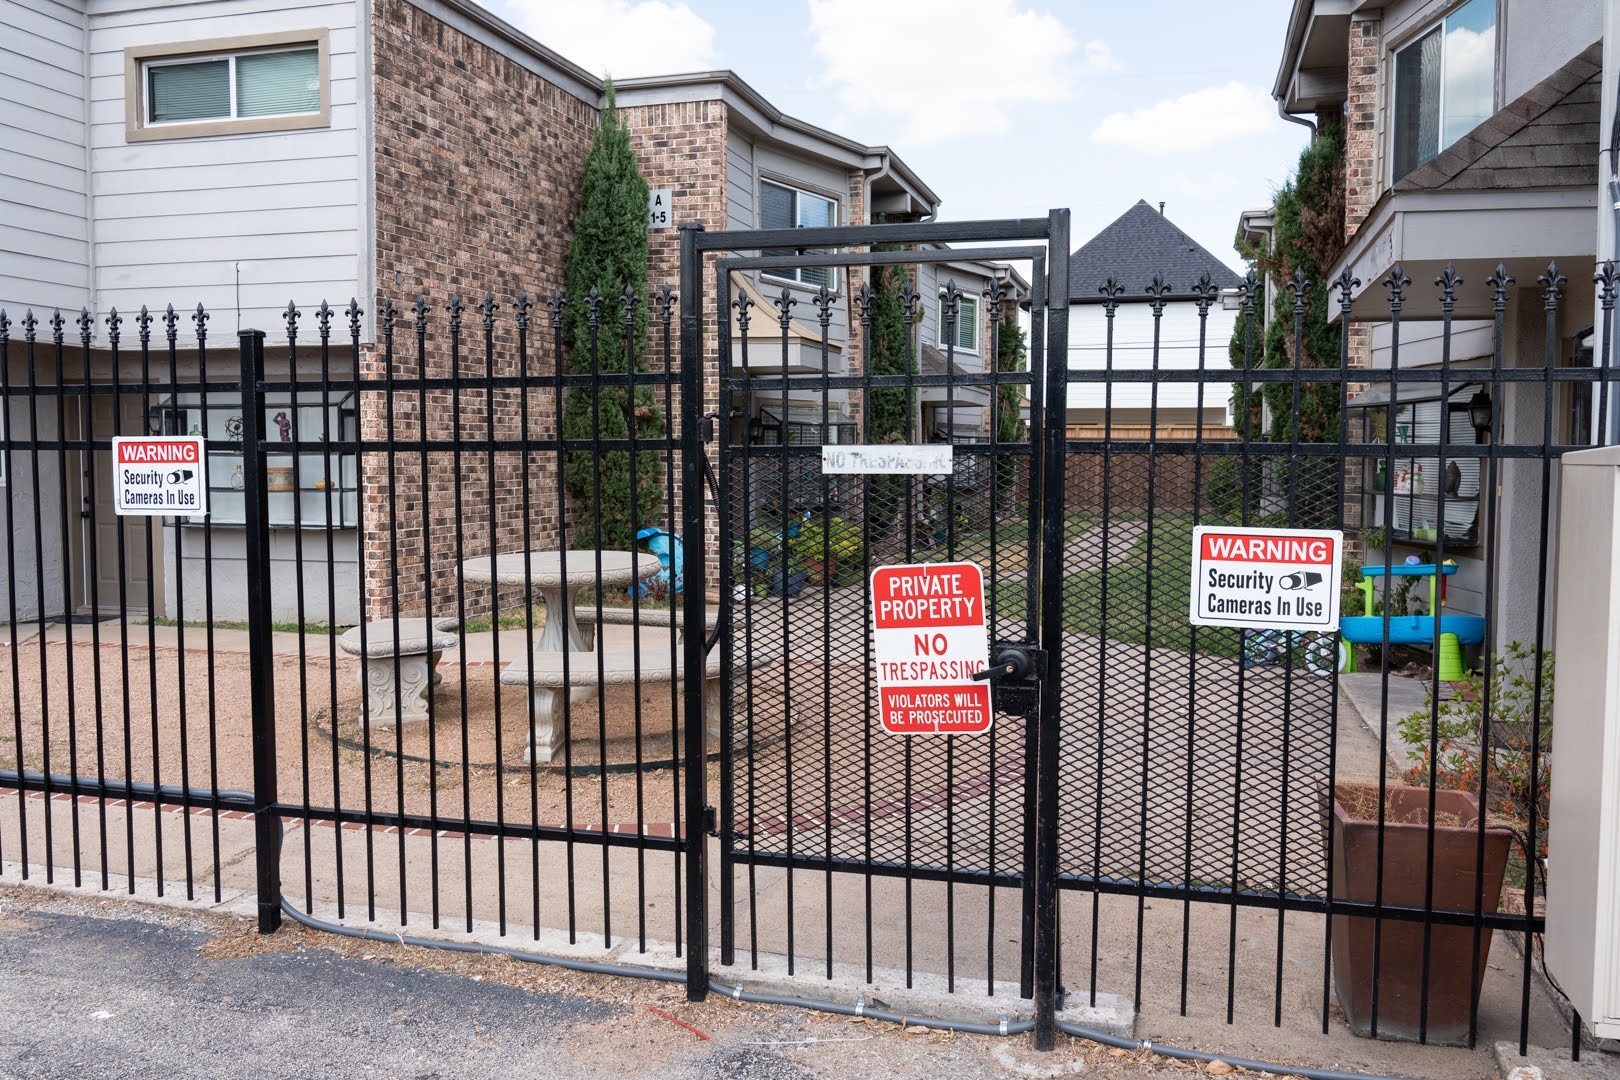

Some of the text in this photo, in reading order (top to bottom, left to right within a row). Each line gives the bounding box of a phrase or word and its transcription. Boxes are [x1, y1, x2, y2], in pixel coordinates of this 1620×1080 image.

[655, 194, 662, 206] A
[651, 211, 666, 223] 1-5
[122, 445, 195, 461] WARNING
[825, 450, 948, 469] NO TRESPA
[124, 469, 163, 488] Security
[124, 489, 195, 505] Cameras In Use
[1208, 538, 1327, 562] WARNING
[889, 574, 963, 597] PRIVATE
[1208, 568, 1273, 594] Security
[880, 597, 976, 621] PROPERTY
[1208, 593, 1322, 617] Cameras In Use
[914, 633, 948, 656] NO
[888, 693, 982, 709] VIOLATORS WILL
[890, 709, 983, 725] BE PROSECUTED
